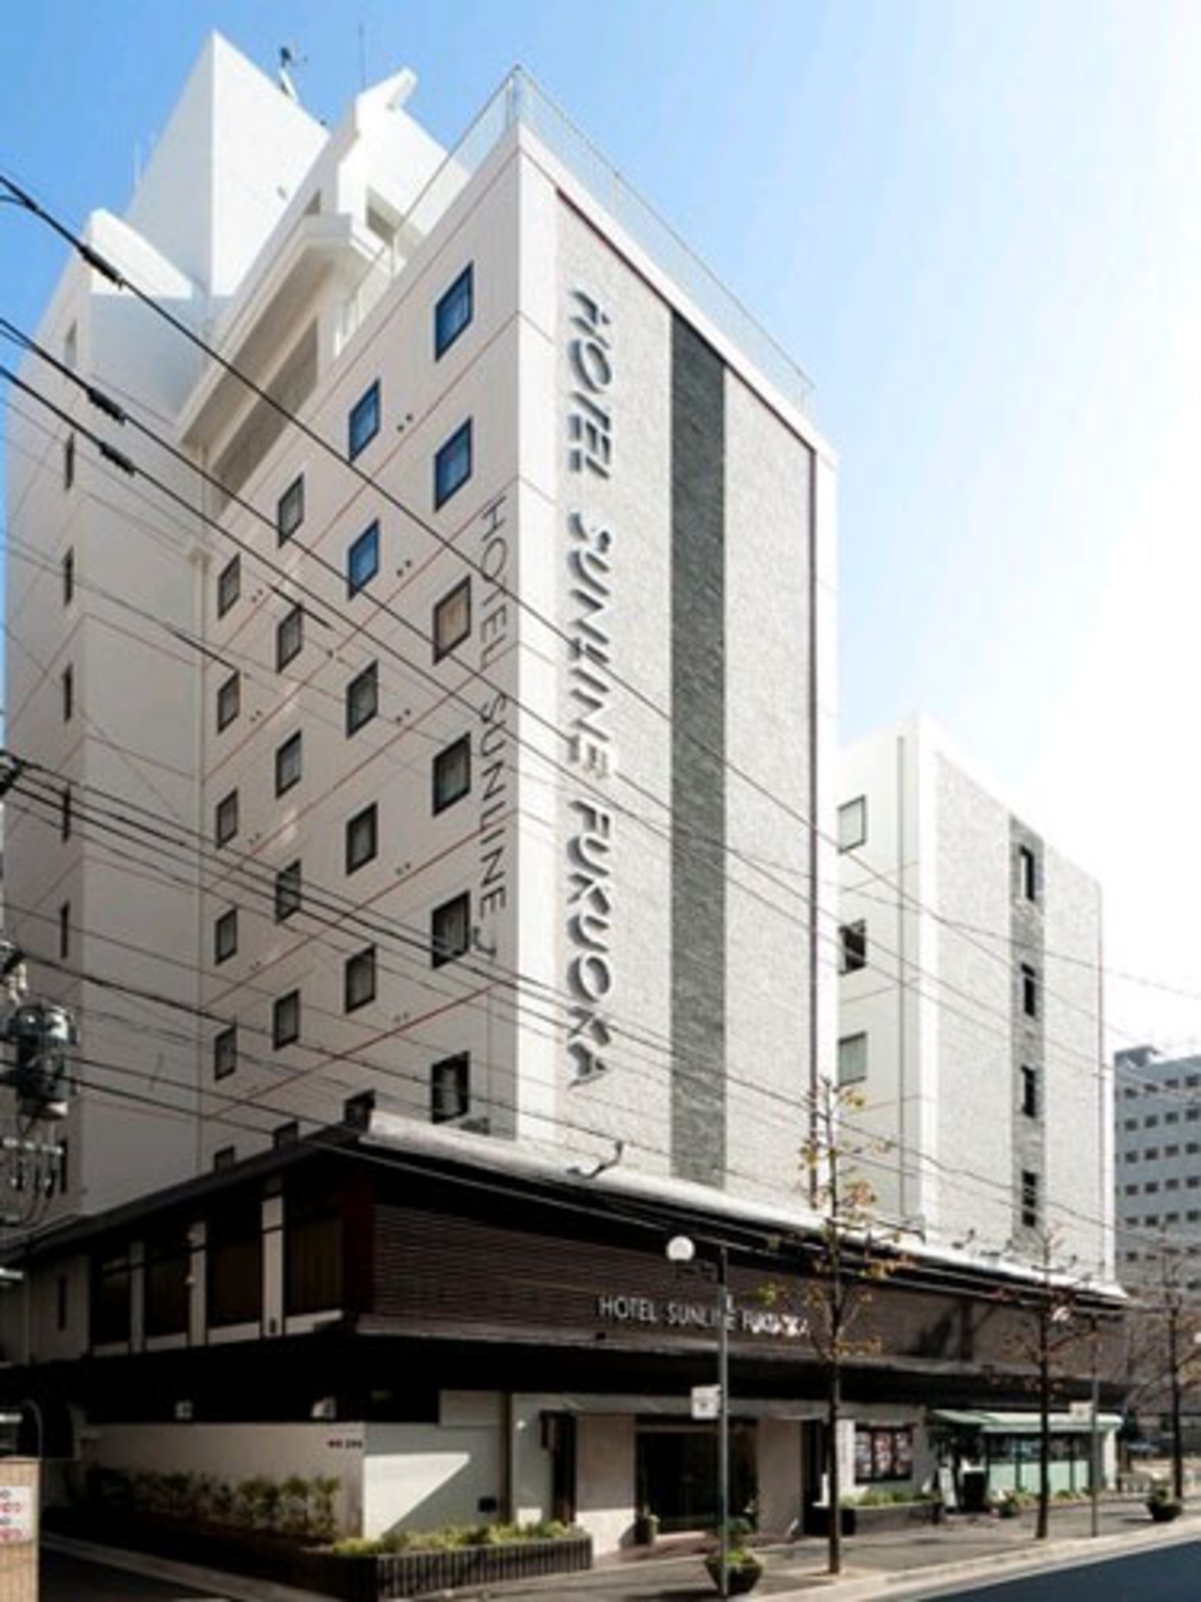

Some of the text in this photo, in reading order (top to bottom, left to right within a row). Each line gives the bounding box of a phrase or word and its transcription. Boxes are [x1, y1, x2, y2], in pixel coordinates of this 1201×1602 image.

[479, 495, 508, 920] HOTEL SUNLINE
[566, 285, 613, 1090] HOTEL SUNLINE FUKUOKA
[598, 1296, 657, 1323] HOTEL
